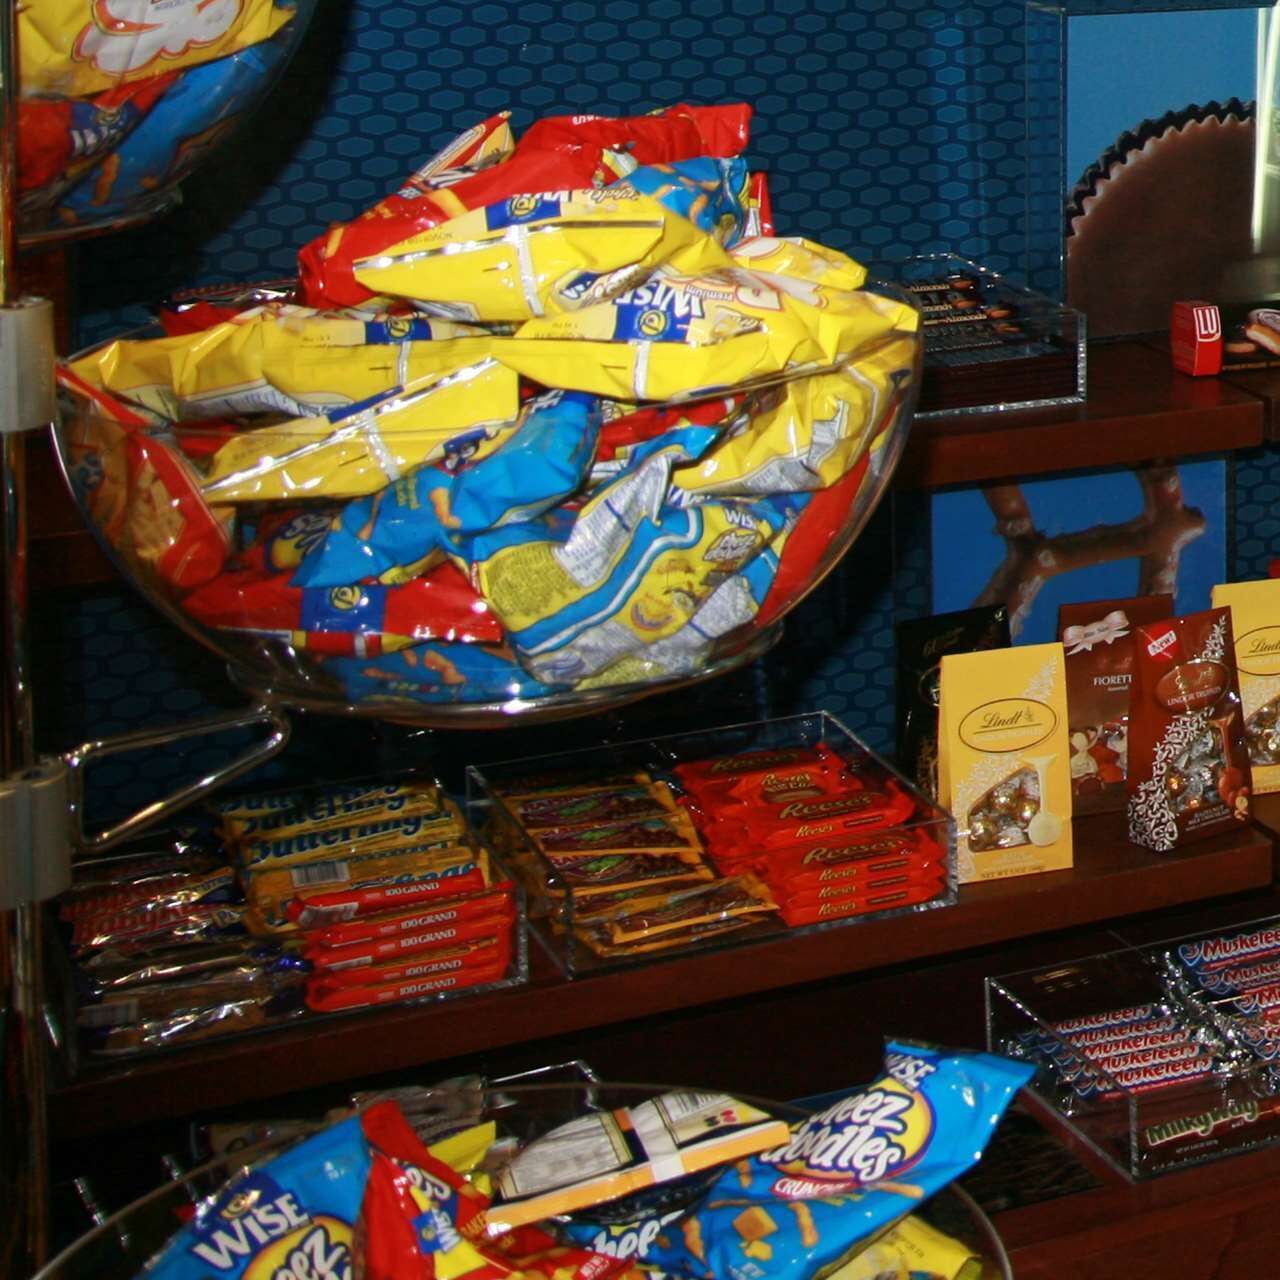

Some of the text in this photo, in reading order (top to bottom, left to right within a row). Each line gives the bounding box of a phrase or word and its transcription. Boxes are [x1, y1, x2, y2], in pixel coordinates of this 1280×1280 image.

[1197, 308, 1217, 335] LU
[1093, 674, 1132, 687] FIORETT
[980, 710, 1024, 729] Lindt
[386, 880, 440, 897] 100 GRAND
[401, 910, 457, 929] 100 GRAND
[401, 928, 457, 948] 100 GRAND
[405, 958, 463, 978] 100 GRAND
[400, 976, 457, 996] 100 GRAND
[193, 1191, 307, 1271] WISE
